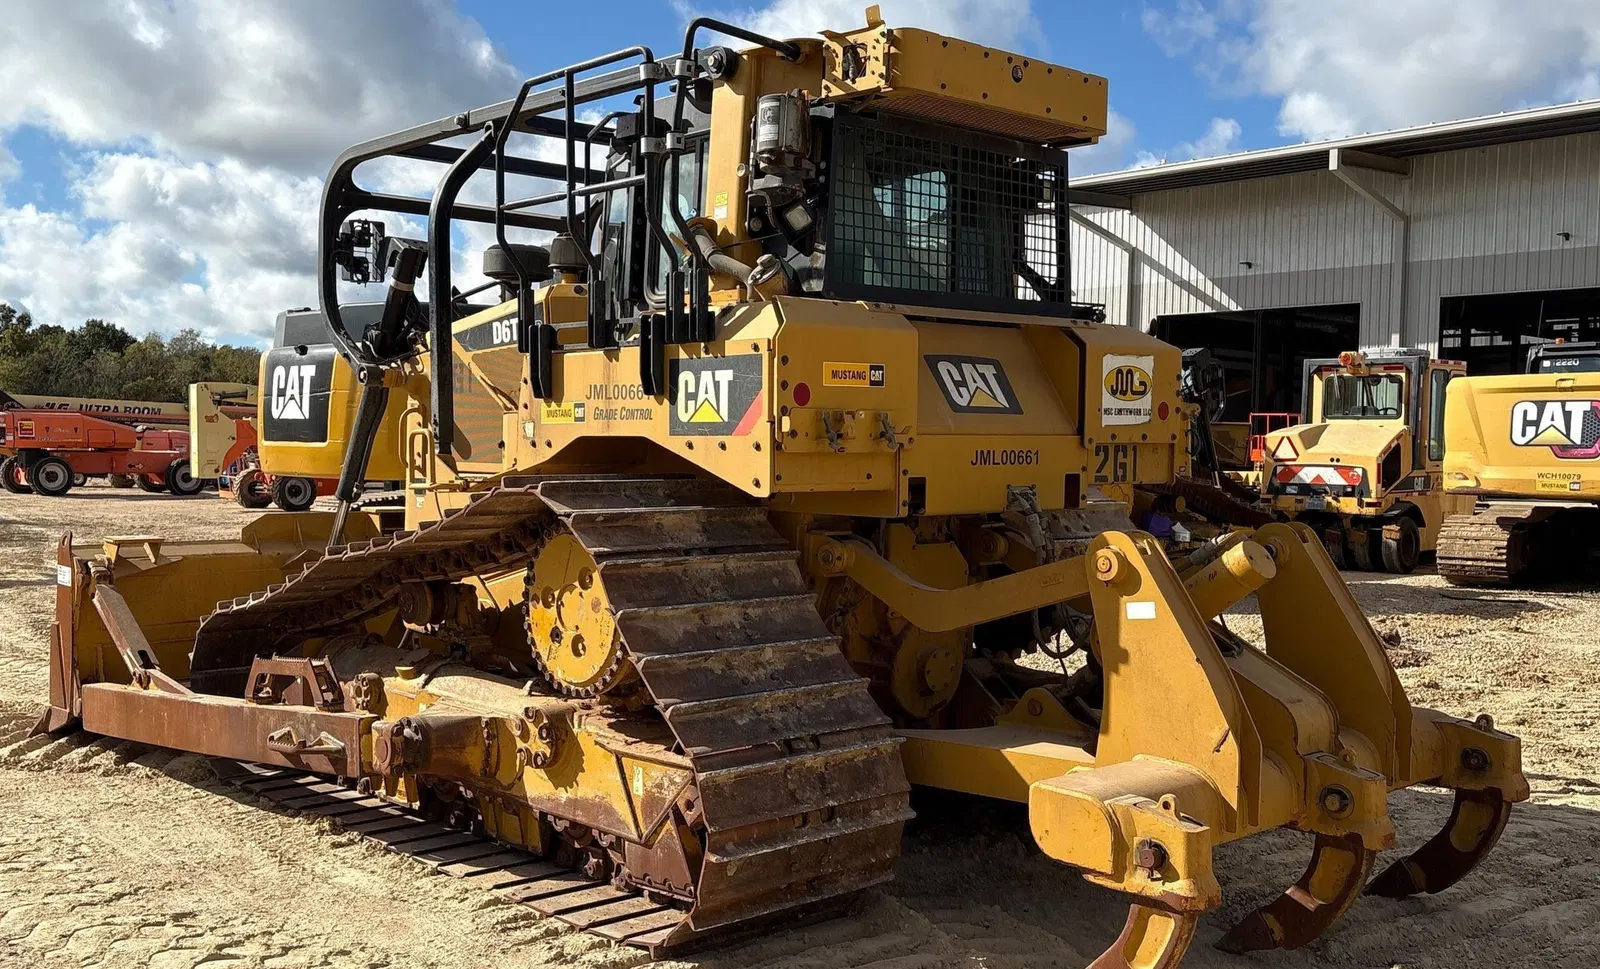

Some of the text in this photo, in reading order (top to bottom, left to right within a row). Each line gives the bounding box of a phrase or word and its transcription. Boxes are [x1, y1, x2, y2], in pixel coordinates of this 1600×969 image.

[492, 318, 519, 345] D6T
[831, 369, 883, 381] MUSTANG CAT
[271, 364, 317, 420] CAT
[585, 384, 651, 400] JML0066
[937, 360, 1010, 408] CAT
[677, 369, 734, 423] CAT
[546, 407, 585, 418] MUSTANG CAT
[1511, 401, 1591, 446] CAT
[970, 449, 1040, 466] JML00661
[1413, 476, 1425, 492] CAT
[1537, 472, 1582, 480] WCH10079
